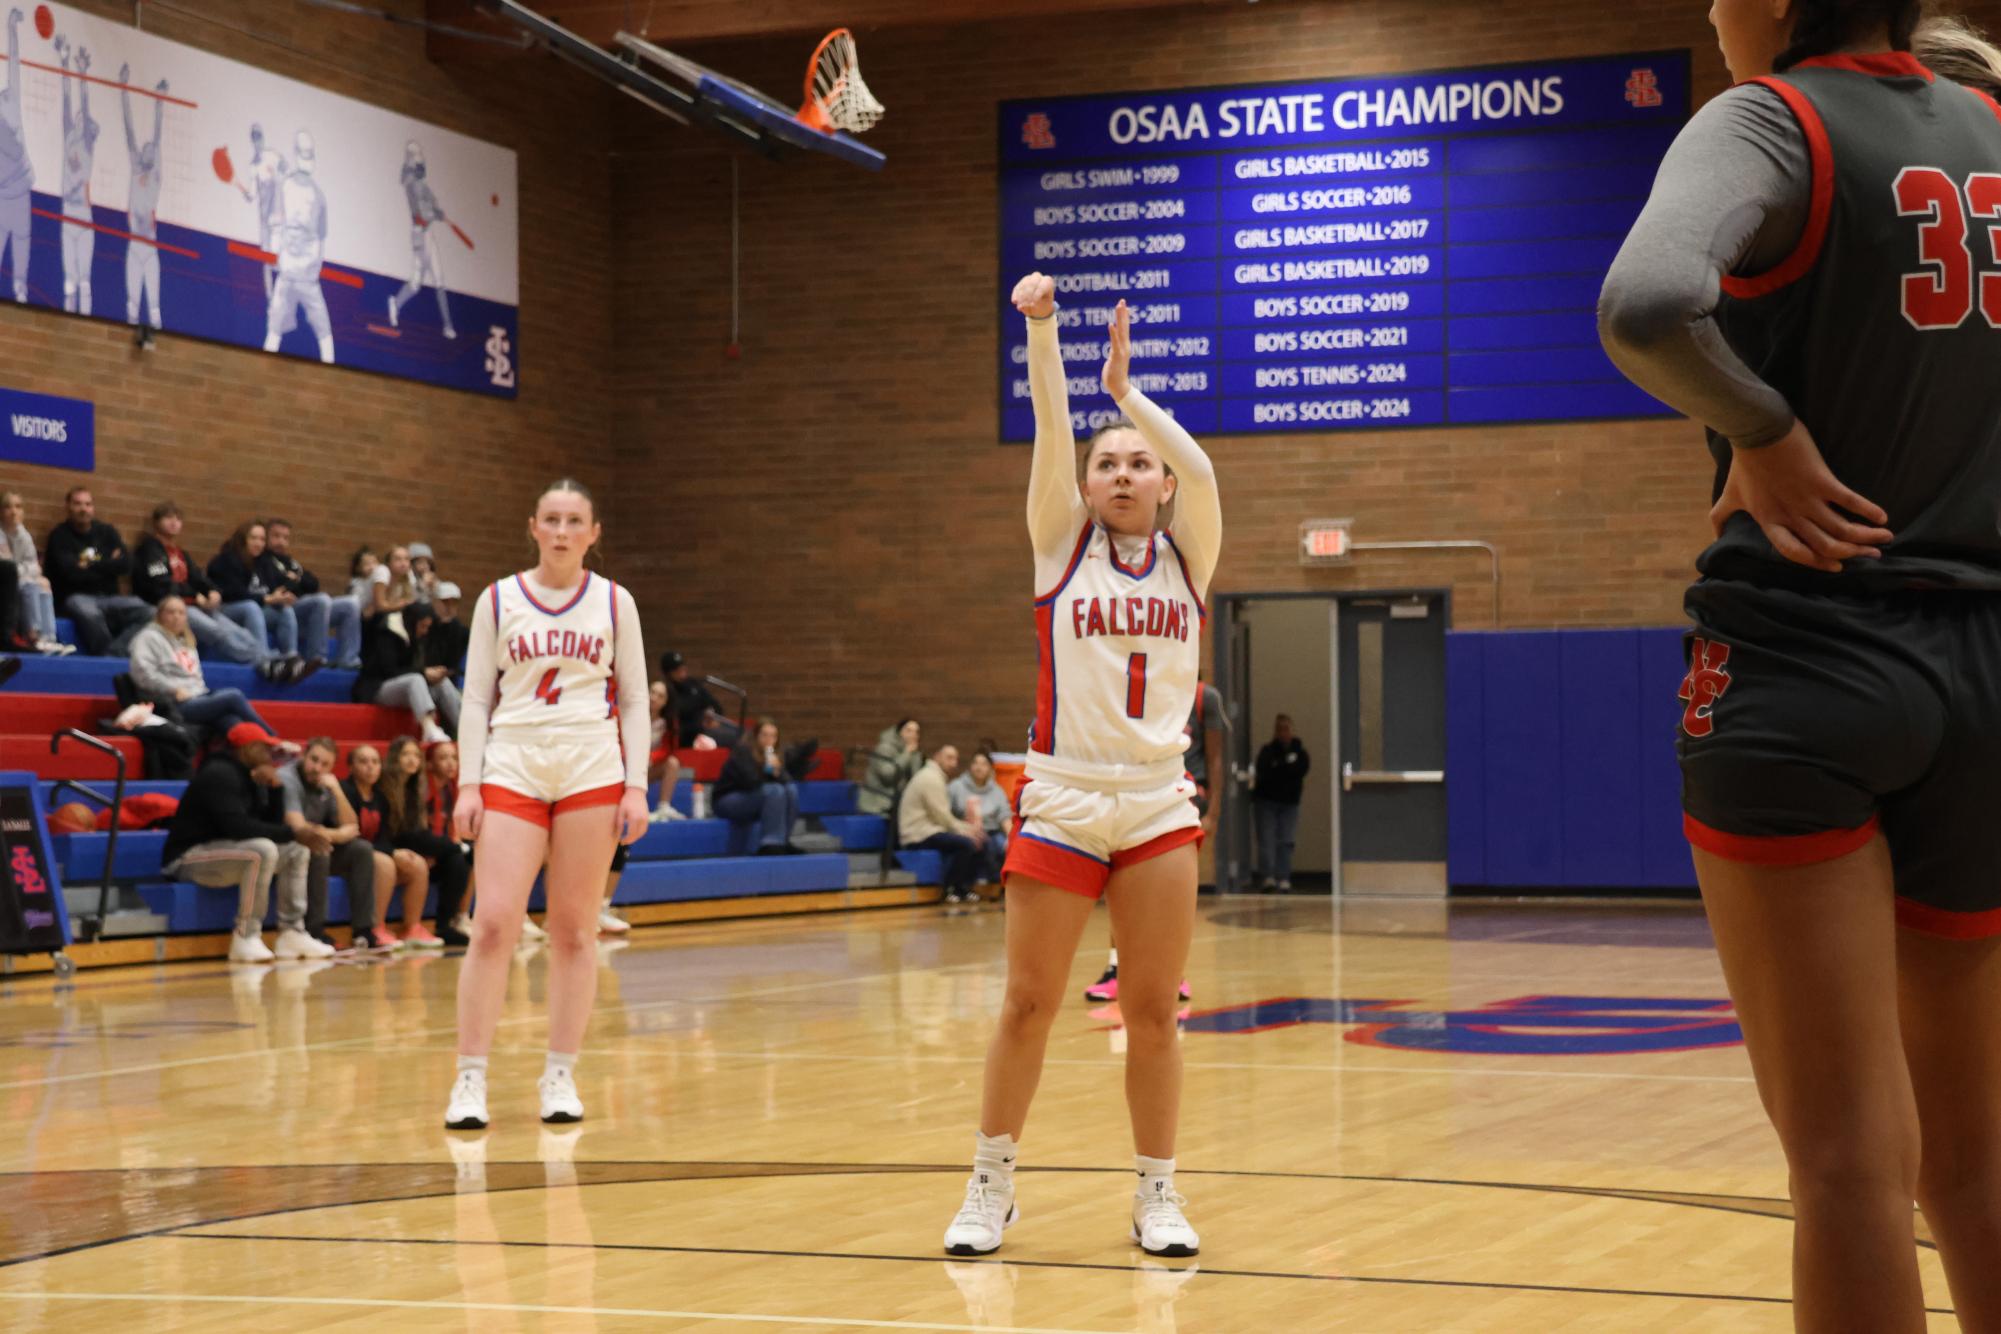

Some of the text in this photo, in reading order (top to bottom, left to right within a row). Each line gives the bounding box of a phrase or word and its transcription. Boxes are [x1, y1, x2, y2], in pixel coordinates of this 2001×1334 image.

[1109, 76, 1564, 144] OSAA STATE CHAMPIONS
[1235, 157, 1282, 179] GIRLS
[1041, 170, 1086, 190] GIRLS
[1252, 191, 1299, 213] GIRLS
[1034, 205, 1076, 225] BOYS
[1234, 227, 1282, 249] GIRLS
[1034, 240, 1076, 260] BOYS
[1234, 262, 1282, 284] GIRLS
[1254, 296, 1298, 318] BOYS
[1254, 331, 1298, 352] BOYS
[1255, 367, 1299, 388] BOYS
[1254, 402, 1298, 423] BOYS
[11, 413, 67, 442] VISITORS
[1072, 597, 1188, 643] FALCONS
[508, 629, 605, 665] FALCONS
[534, 667, 562, 705] 4
[1126, 652, 1147, 719] 1
